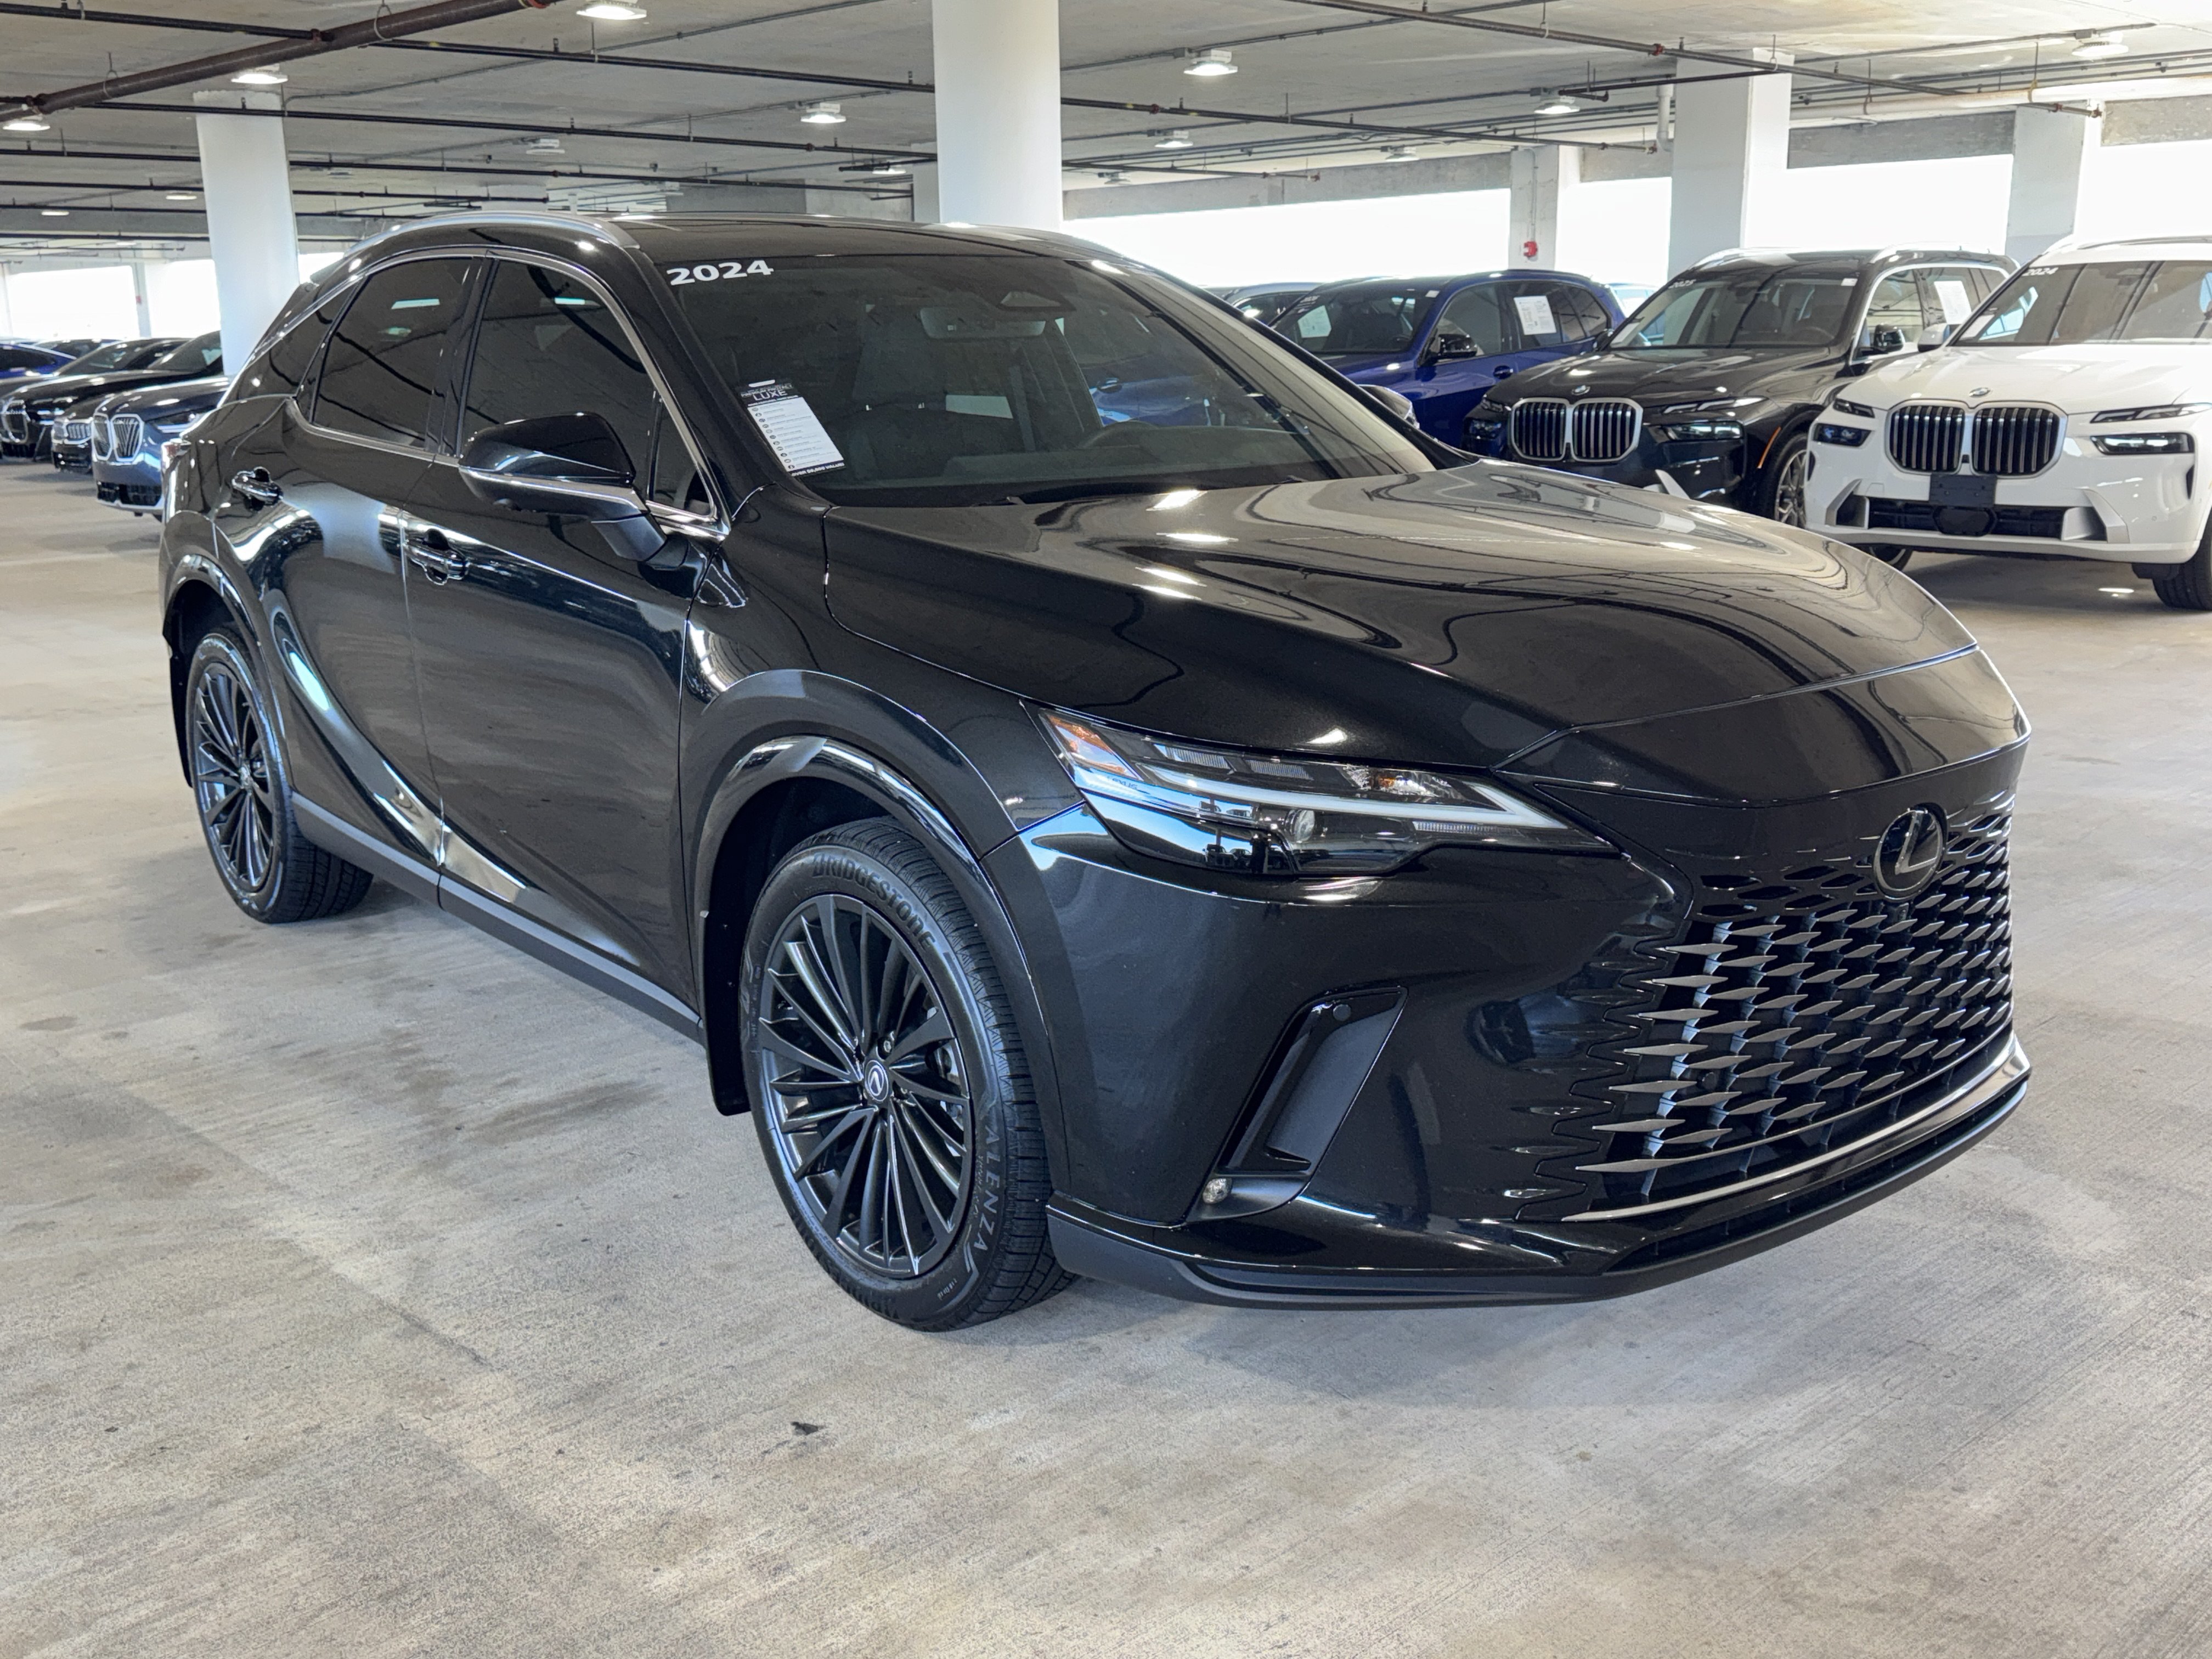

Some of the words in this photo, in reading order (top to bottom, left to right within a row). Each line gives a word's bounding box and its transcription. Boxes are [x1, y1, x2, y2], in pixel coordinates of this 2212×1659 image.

[666, 259, 775, 286] 2024
[2022, 267, 2059, 276] 2024
[752, 389, 788, 401] LUXE
[1107, 776, 1138, 790] EXUS
[812, 853, 936, 952] BRIDGESTONE
[974, 1125, 1000, 1251] ALENZA
